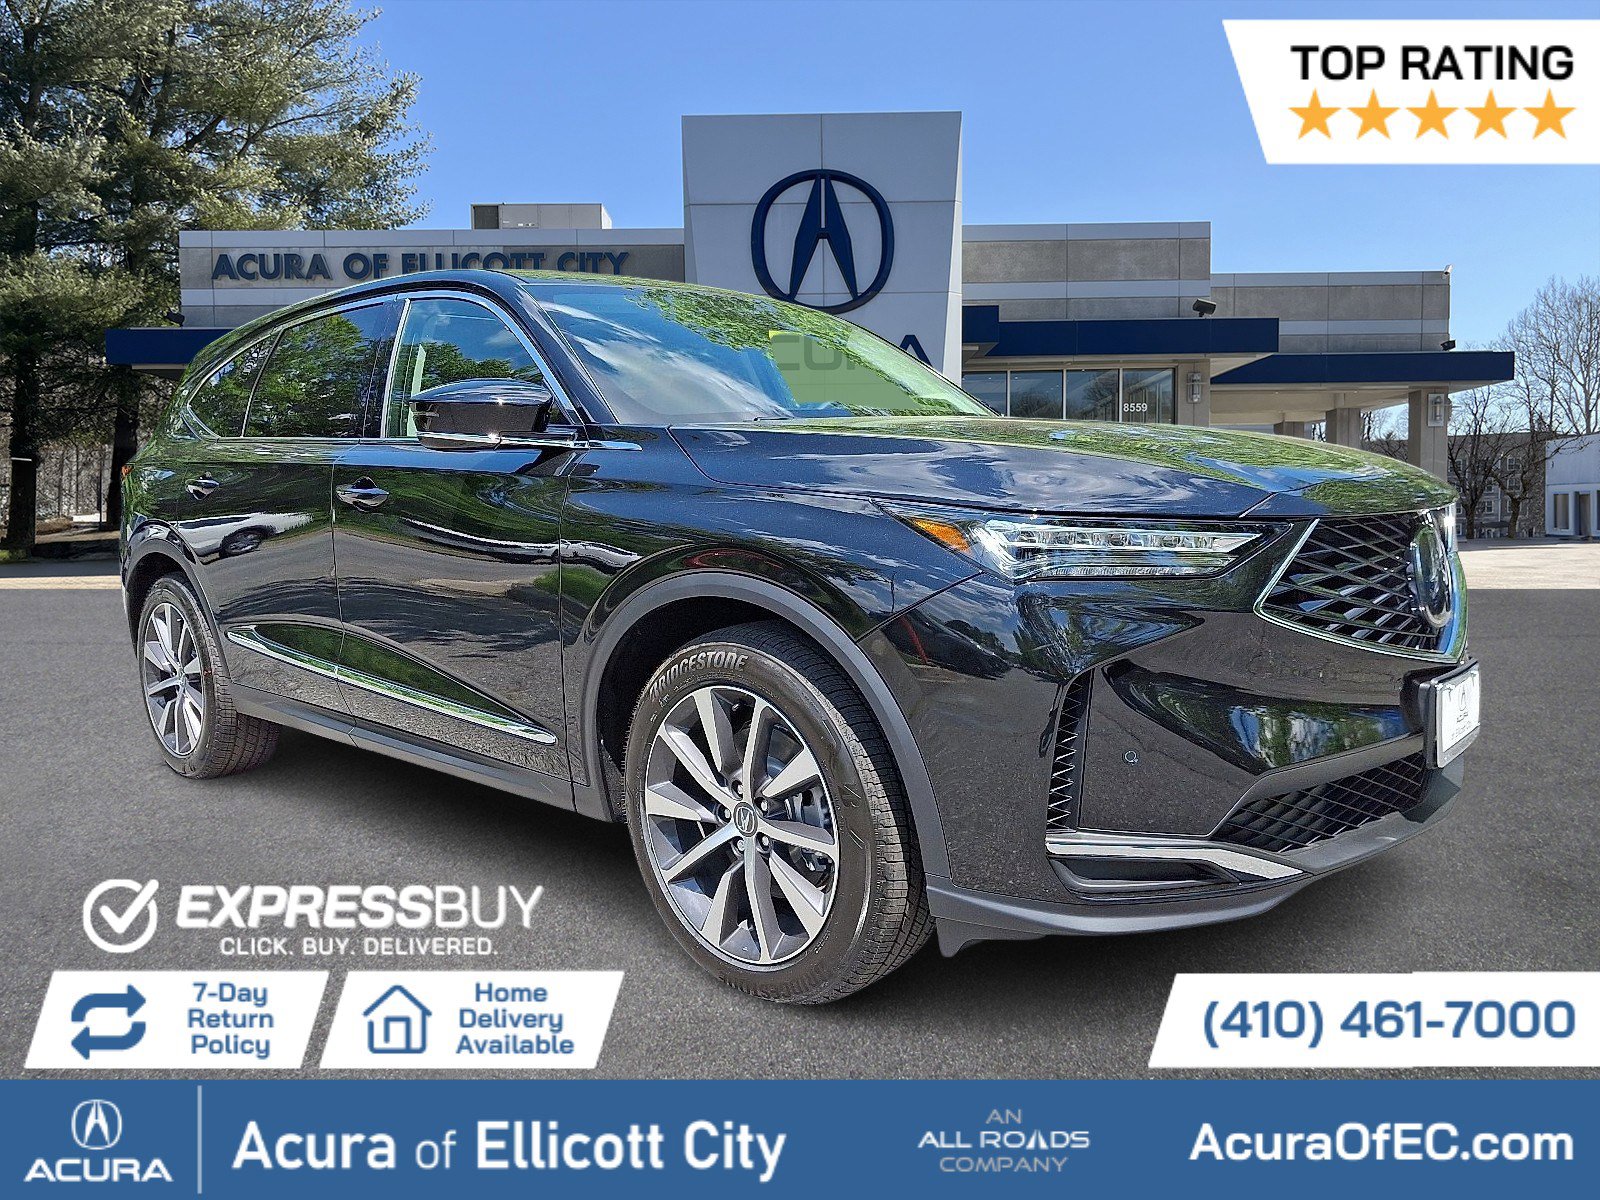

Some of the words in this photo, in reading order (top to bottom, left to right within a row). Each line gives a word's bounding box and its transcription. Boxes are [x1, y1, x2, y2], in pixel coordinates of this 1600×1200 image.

[211, 253, 333, 280] ACURA
[343, 252, 388, 280] OF
[557, 251, 630, 275] CITY
[1123, 402, 1148, 413] 8559
[649, 651, 749, 702] BRIDGESTONE
